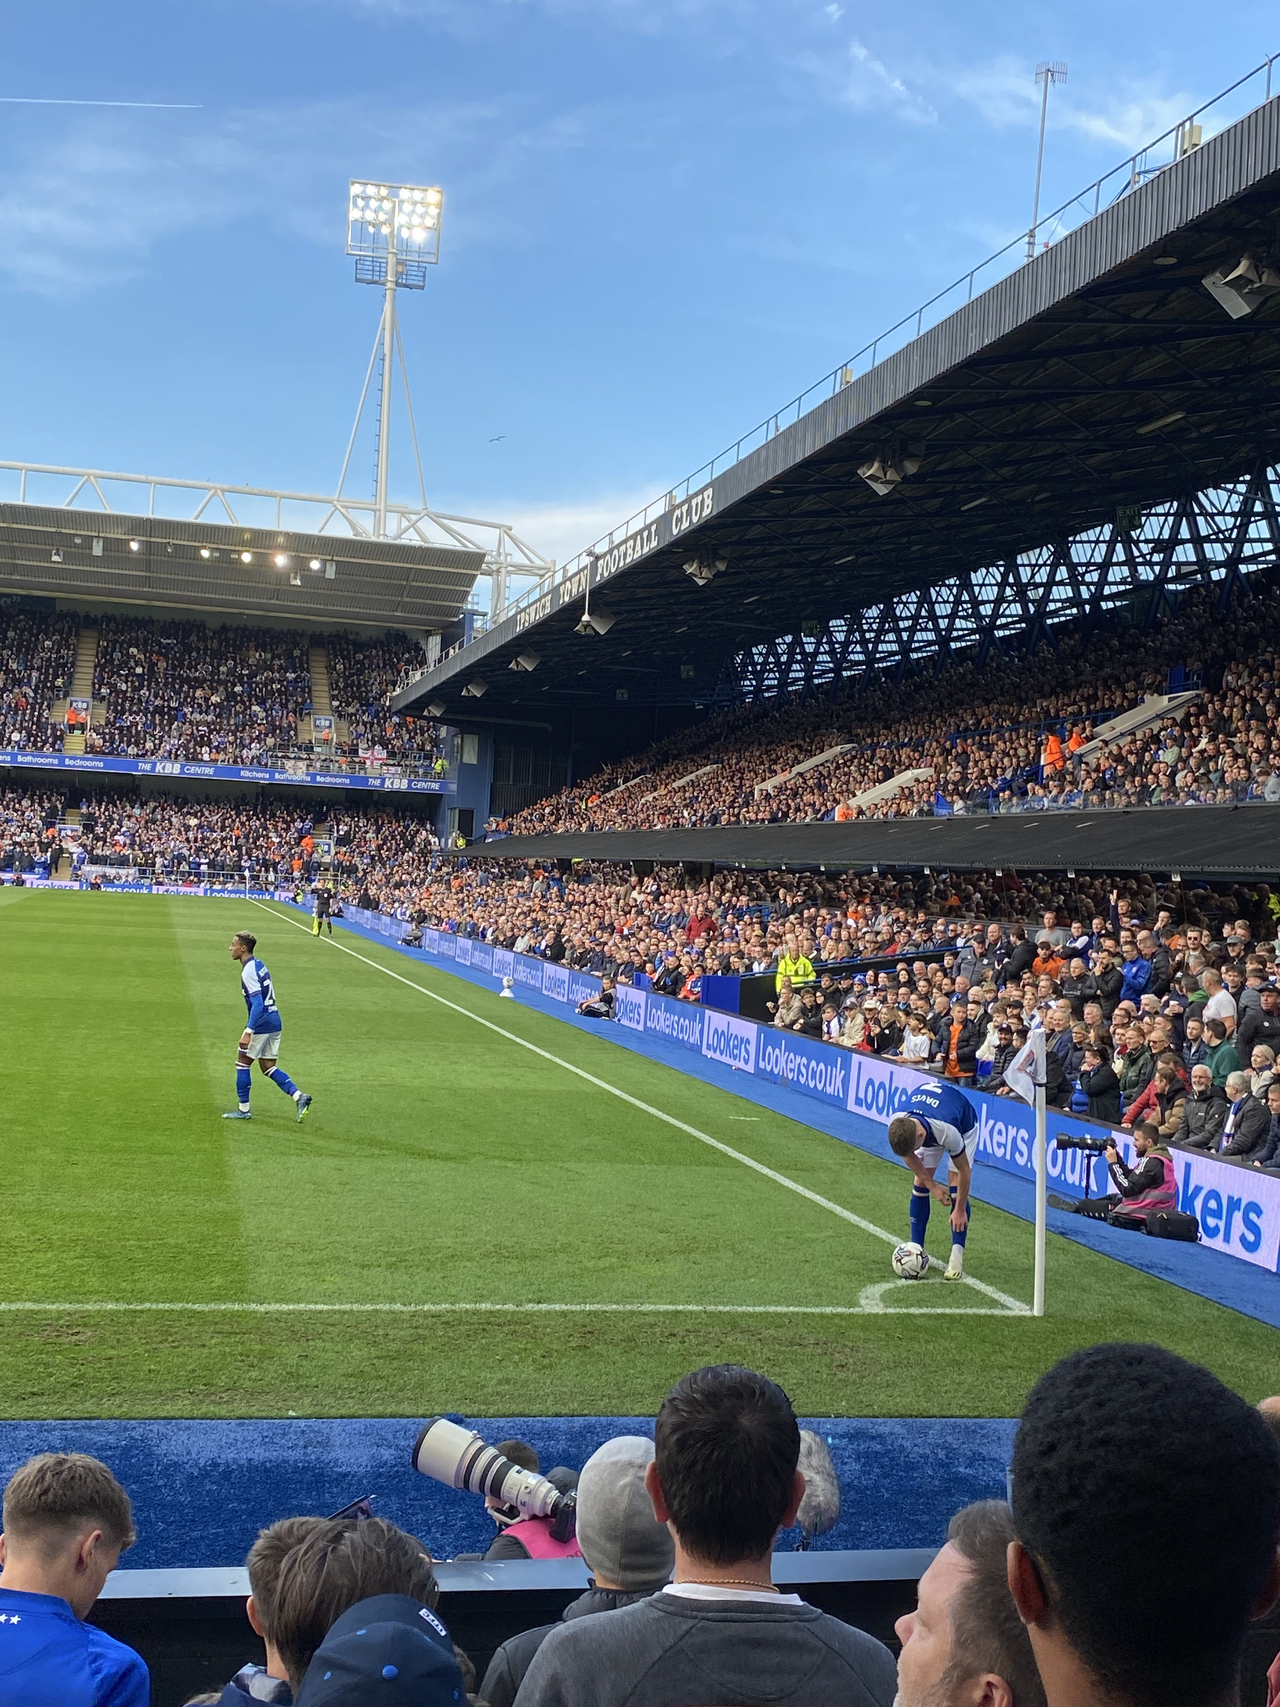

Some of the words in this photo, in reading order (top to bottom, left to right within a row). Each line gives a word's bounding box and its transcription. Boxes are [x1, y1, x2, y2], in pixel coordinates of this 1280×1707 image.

[1119, 506, 1139, 517] EXIT
[516, 594, 551, 632] IPSWICH
[559, 569, 588, 604] TOWN
[596, 523, 659, 581] FOOTBALL
[672, 487, 713, 536] CLUB
[72, 701, 87, 709] KBB
[17, 755, 58, 765] Bathrooms
[65, 758, 103, 767] Bedrooms
[138, 762, 152, 771] THE
[155, 762, 181, 774] KBB
[184, 765, 215, 775] CENTRE
[240, 770, 269, 778] Kitchens
[275, 772, 311, 781] Bathrooms
[316, 775, 350, 784] Bedrooms
[368, 778, 381, 786] THE
[384, 777, 408, 789] KBB
[411, 781, 440, 790] CENTRE
[616, 990, 641, 1025] ookers
[646, 999, 702, 1046] Lookers.co.uk
[706, 1015, 750, 1066] Lookers
[759, 1034, 846, 1098] Lookers.co.uk
[911, 1094, 940, 1108] DAVIS
[1177, 1162, 1264, 1253] kers
